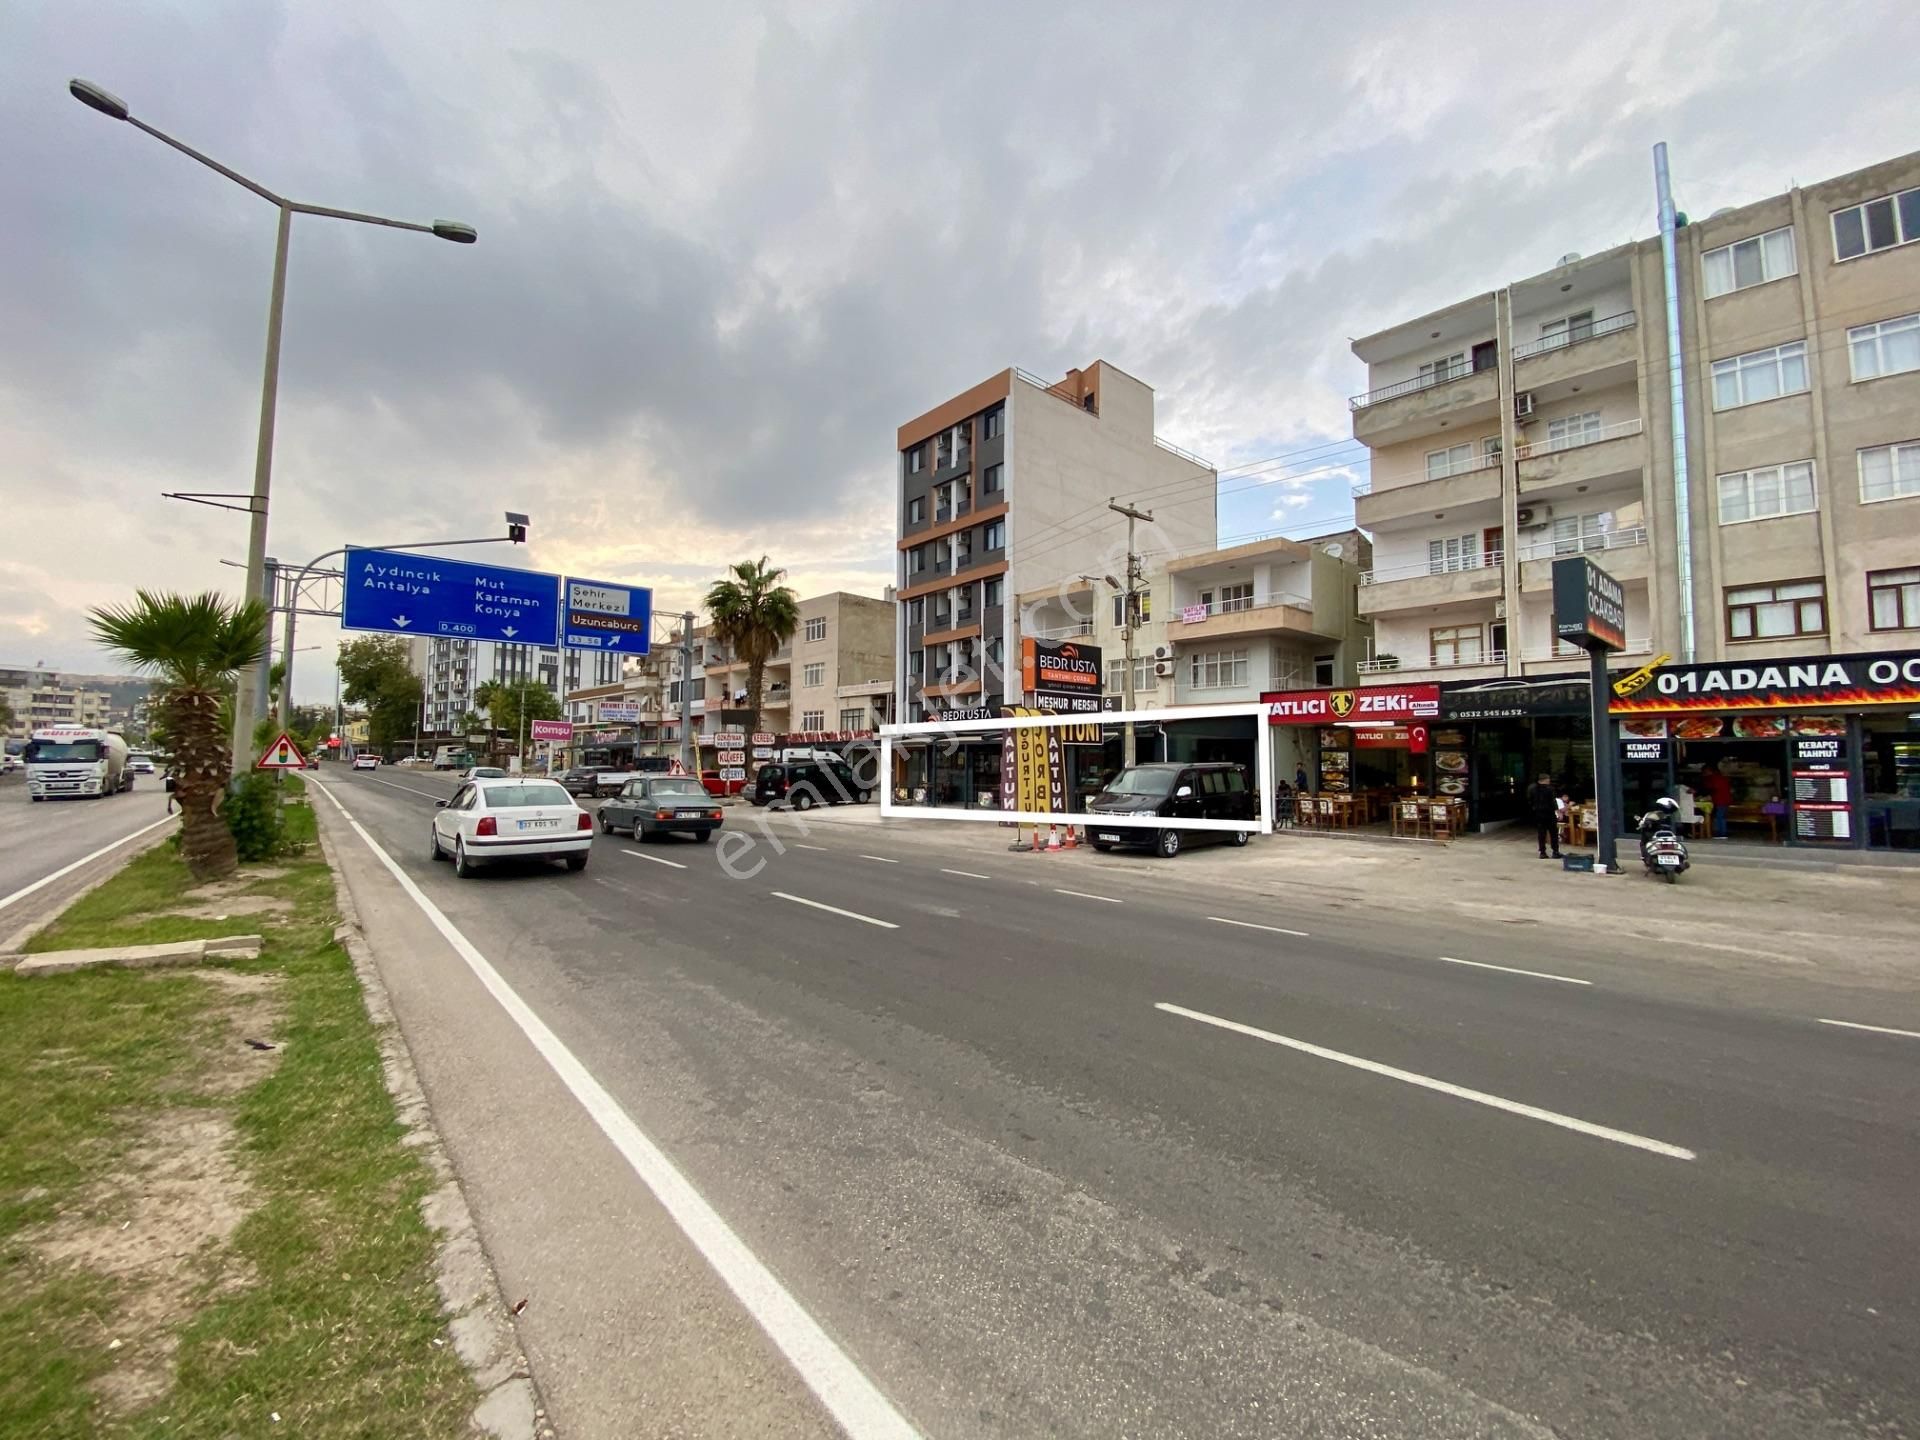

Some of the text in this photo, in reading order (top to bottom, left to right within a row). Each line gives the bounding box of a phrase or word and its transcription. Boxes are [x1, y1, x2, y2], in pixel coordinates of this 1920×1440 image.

[363, 563, 441, 582] Aydıncık
[363, 577, 431, 595] Antalya
[475, 577, 505, 590] Mut
[1586, 566, 1623, 607] 01 ADANA
[475, 590, 540, 607] Karaman
[475, 603, 520, 618] Konya
[572, 615, 639, 631] Uzuncaburç
[534, 725, 570, 736] Komşu
[1626, 743, 1661, 751] KEBAPÇI
[1798, 741, 1838, 750] KEBAPÇI
[1798, 749, 1838, 758] MAHMUT
